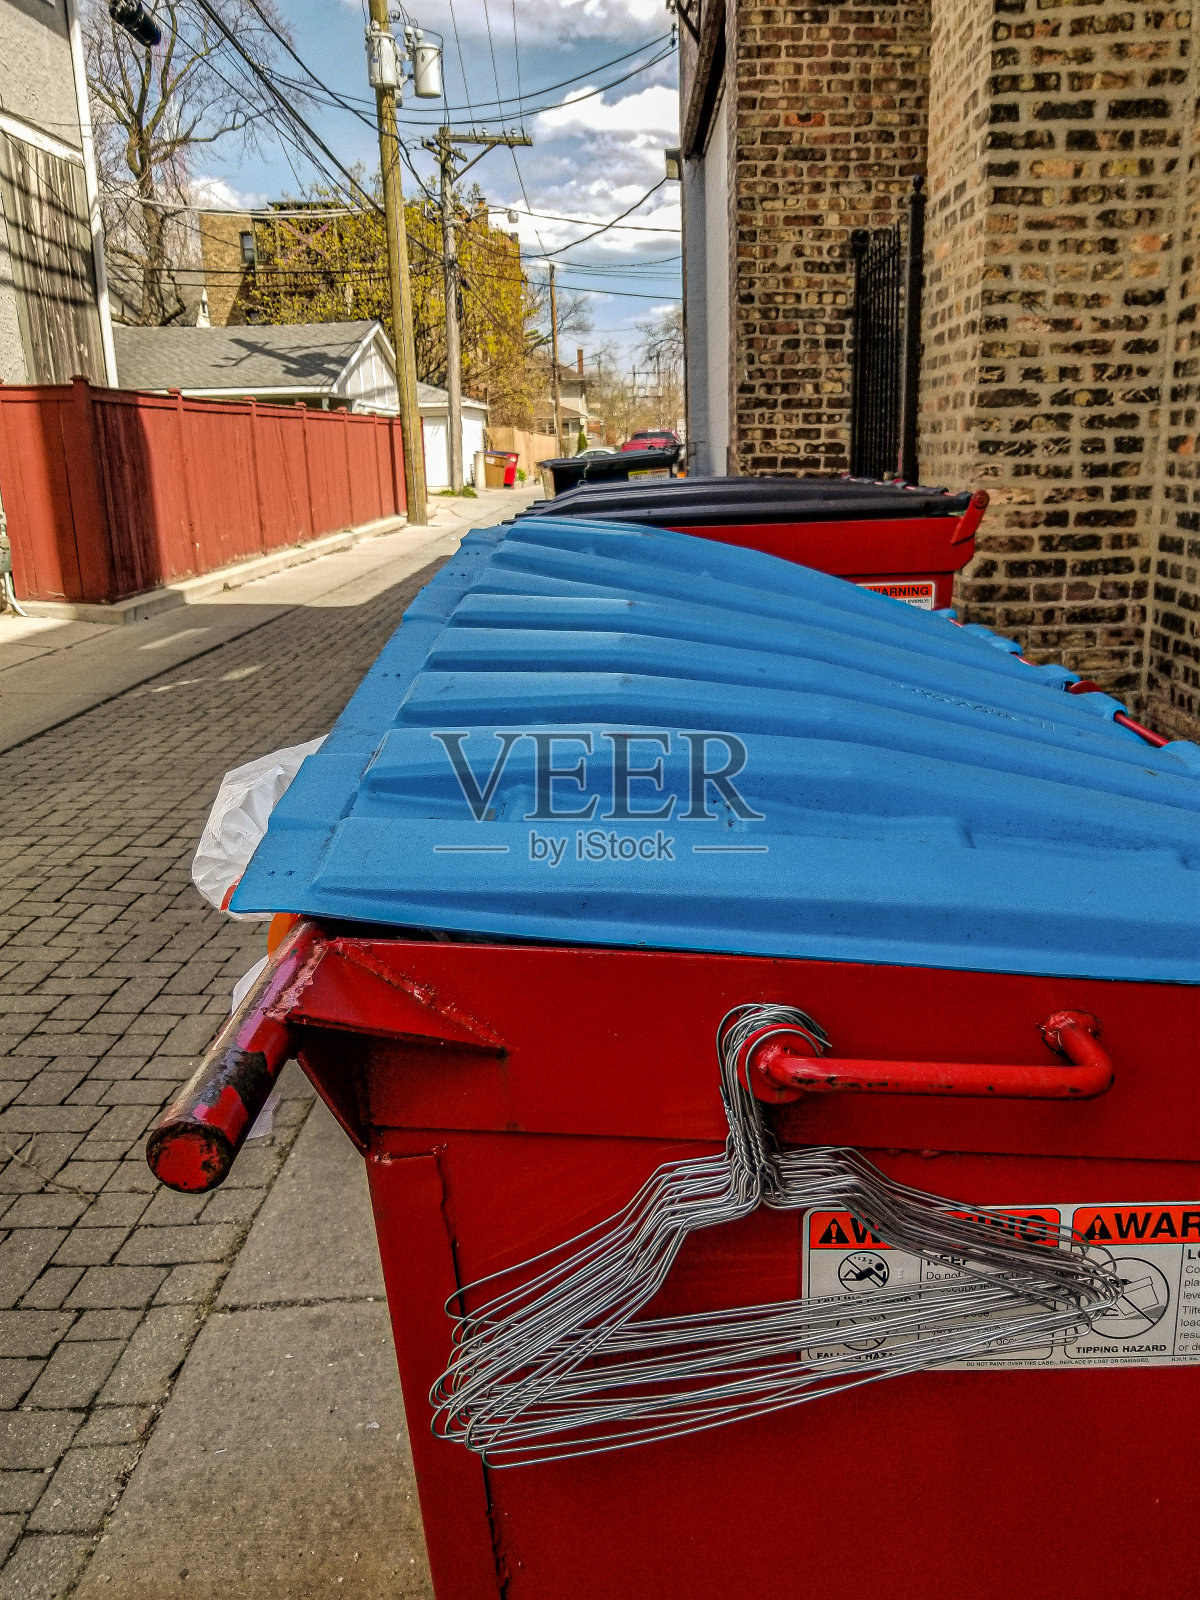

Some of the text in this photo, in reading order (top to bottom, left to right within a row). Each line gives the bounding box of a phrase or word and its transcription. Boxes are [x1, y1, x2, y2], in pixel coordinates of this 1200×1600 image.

[926, 1271, 941, 1280] Do
[1075, 1344, 1167, 1354] TIPPING HAZARD
